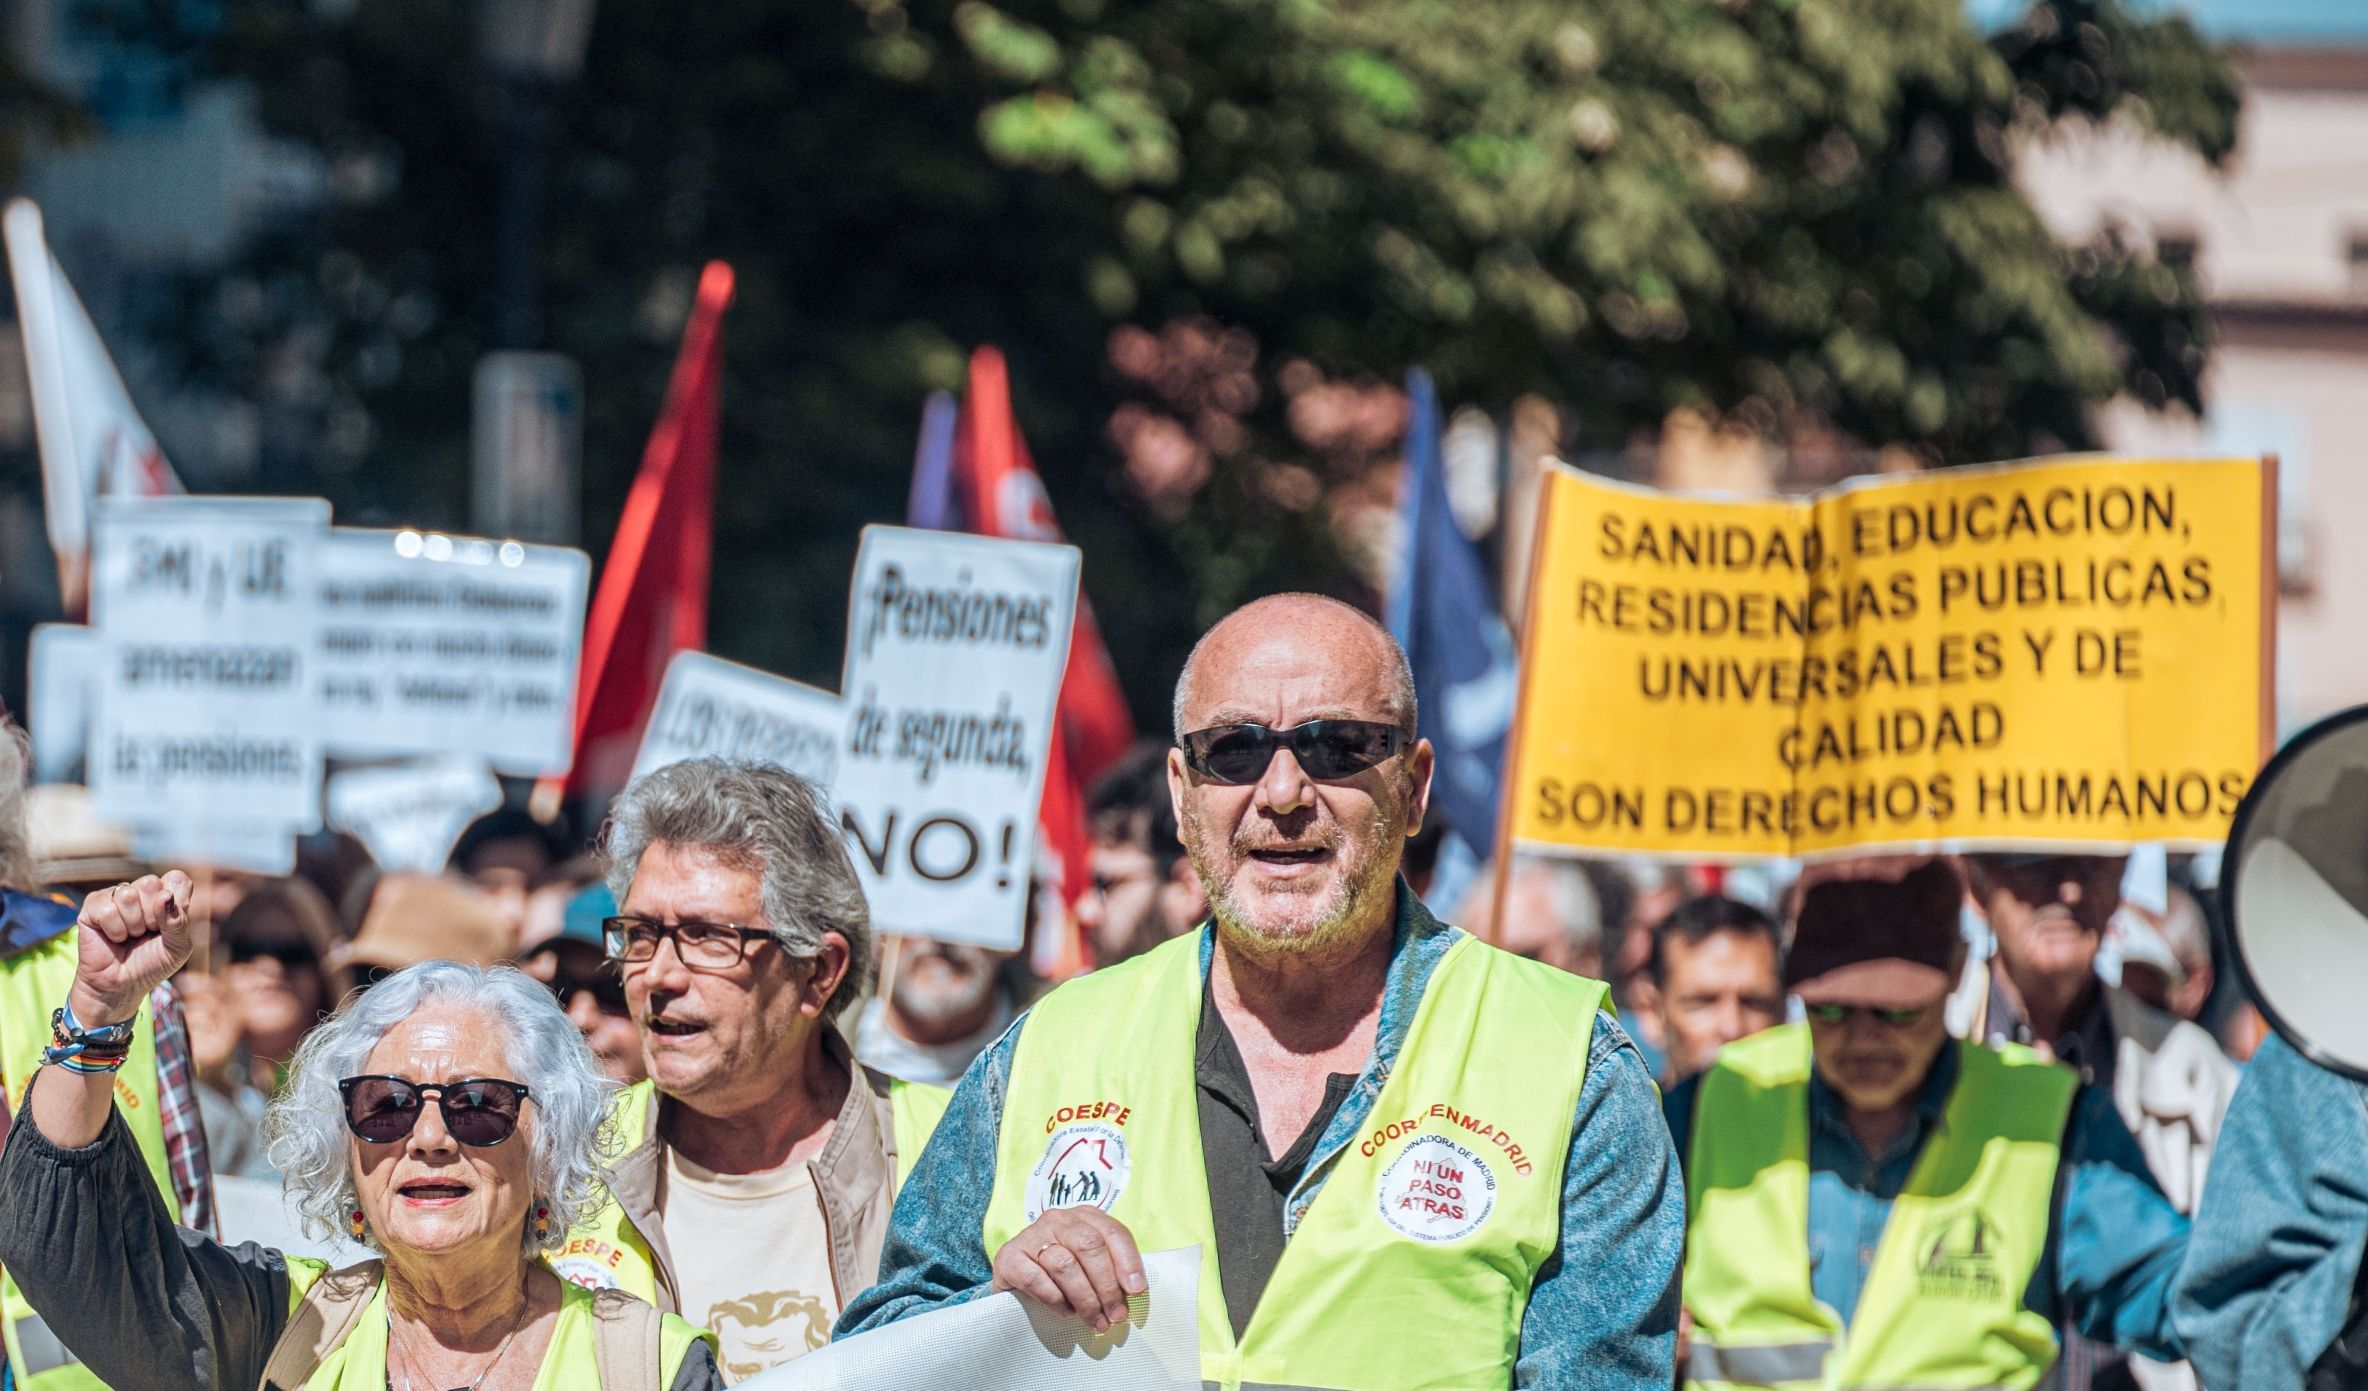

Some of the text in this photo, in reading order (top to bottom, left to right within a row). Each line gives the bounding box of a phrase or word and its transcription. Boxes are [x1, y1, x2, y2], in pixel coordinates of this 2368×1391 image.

[1600, 485, 2191, 577] SANIDAD, EDUCACION,
[1577, 571, 1918, 638] RESIDENCIAS
[1640, 628, 2143, 705] UNIVERSALES Y DE
[850, 683, 888, 757] de
[1779, 701, 2005, 776] CALIDAD
[1537, 770, 2247, 840] SON DERECHOS HUMANOS
[1045, 1101, 1131, 1134] COESPE
[1360, 1103, 1533, 1178] COORENMADRID
[1409, 1179, 1462, 1200] PASO
[1413, 1159, 1464, 1184] NI UN
[1457, 1146, 1474, 1160] DE
[1471, 1157, 1496, 1191] MADRID
[1398, 1196, 1464, 1220] ATRAS
